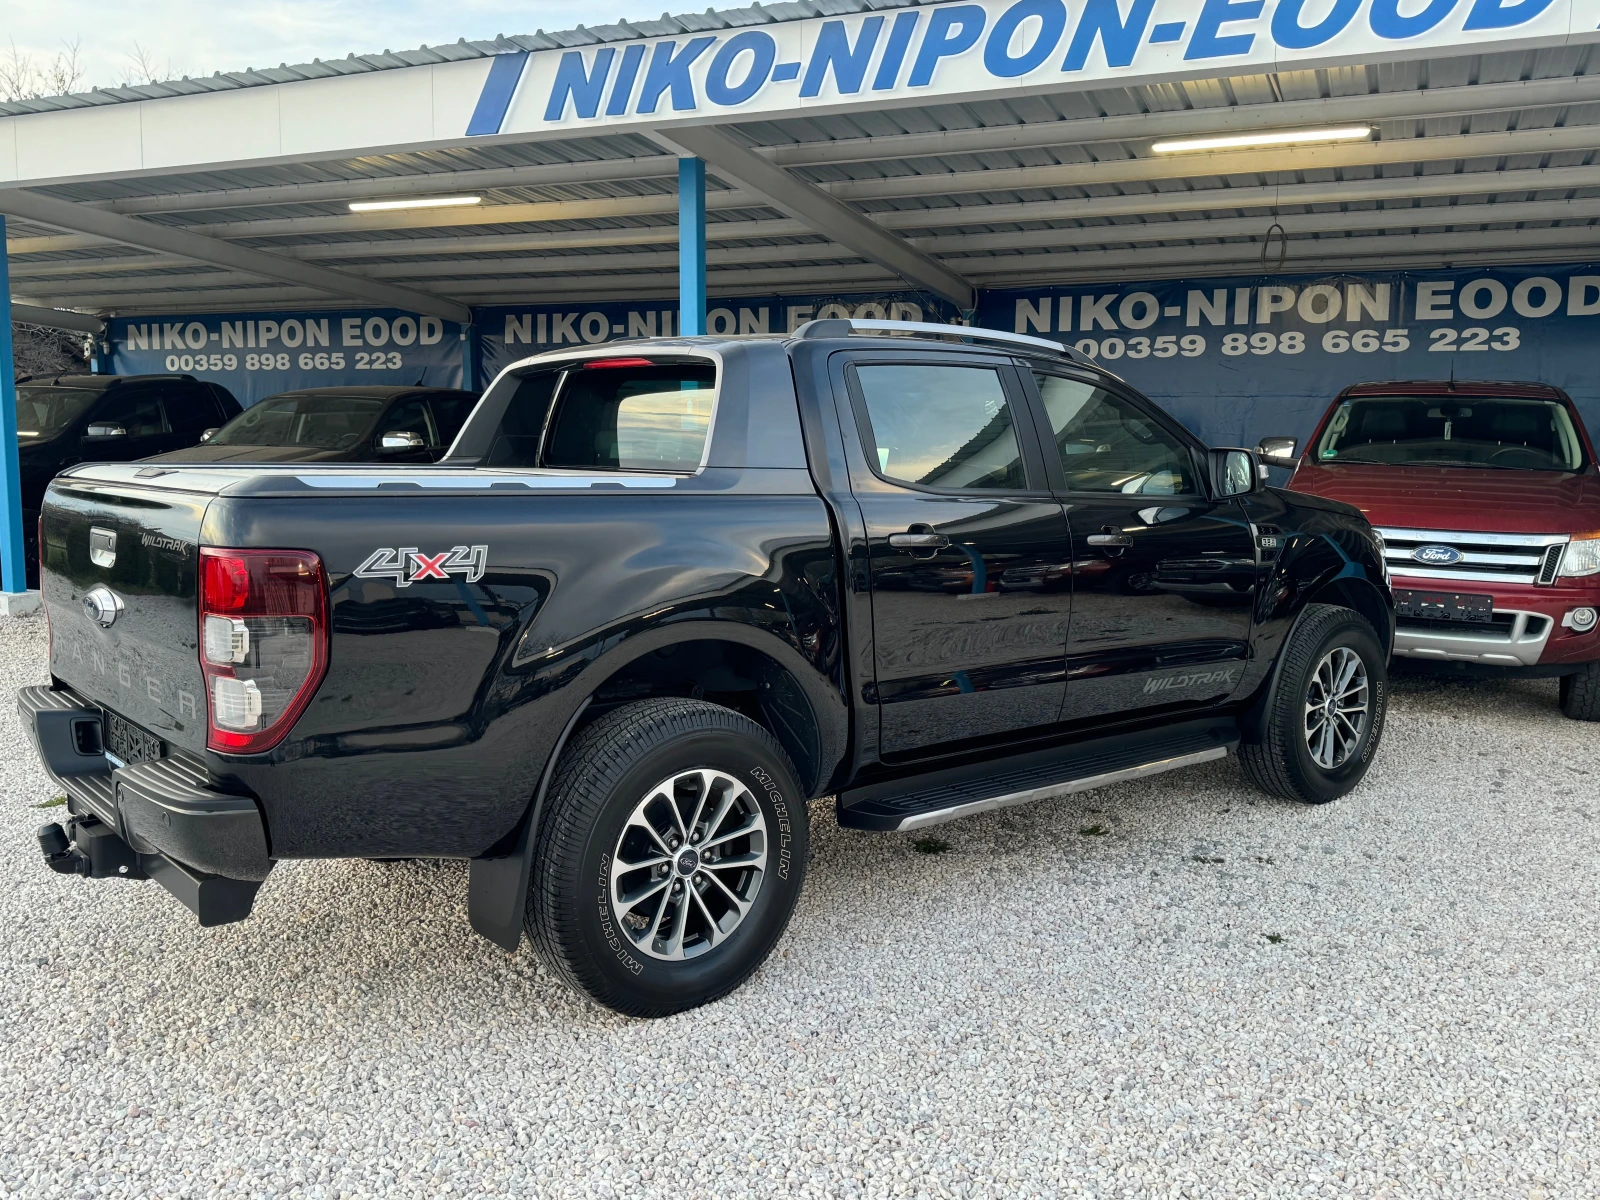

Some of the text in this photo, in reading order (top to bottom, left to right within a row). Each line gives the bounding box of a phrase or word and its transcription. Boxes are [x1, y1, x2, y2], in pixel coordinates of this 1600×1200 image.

[542, 0, 1555, 122] NIKO-NIPON-E
[1014, 275, 1600, 335] NIKO-NIPON EOOD
[127, 316, 444, 351] NIKO-NIPON EOOD
[504, 306, 772, 344] NIKO-NION
[165, 351, 403, 372] 00359 898 665 223
[1074, 326, 1521, 361] 00359 898 665 223
[141, 532, 189, 555] WILDTRAK
[1422, 549, 1451, 561] Ford
[1142, 669, 1235, 694] WILDTRAK
[1362, 681, 1384, 763] MICHELIN
[750, 766, 792, 881] MICHELIN
[597, 853, 643, 976] MICHELIN
